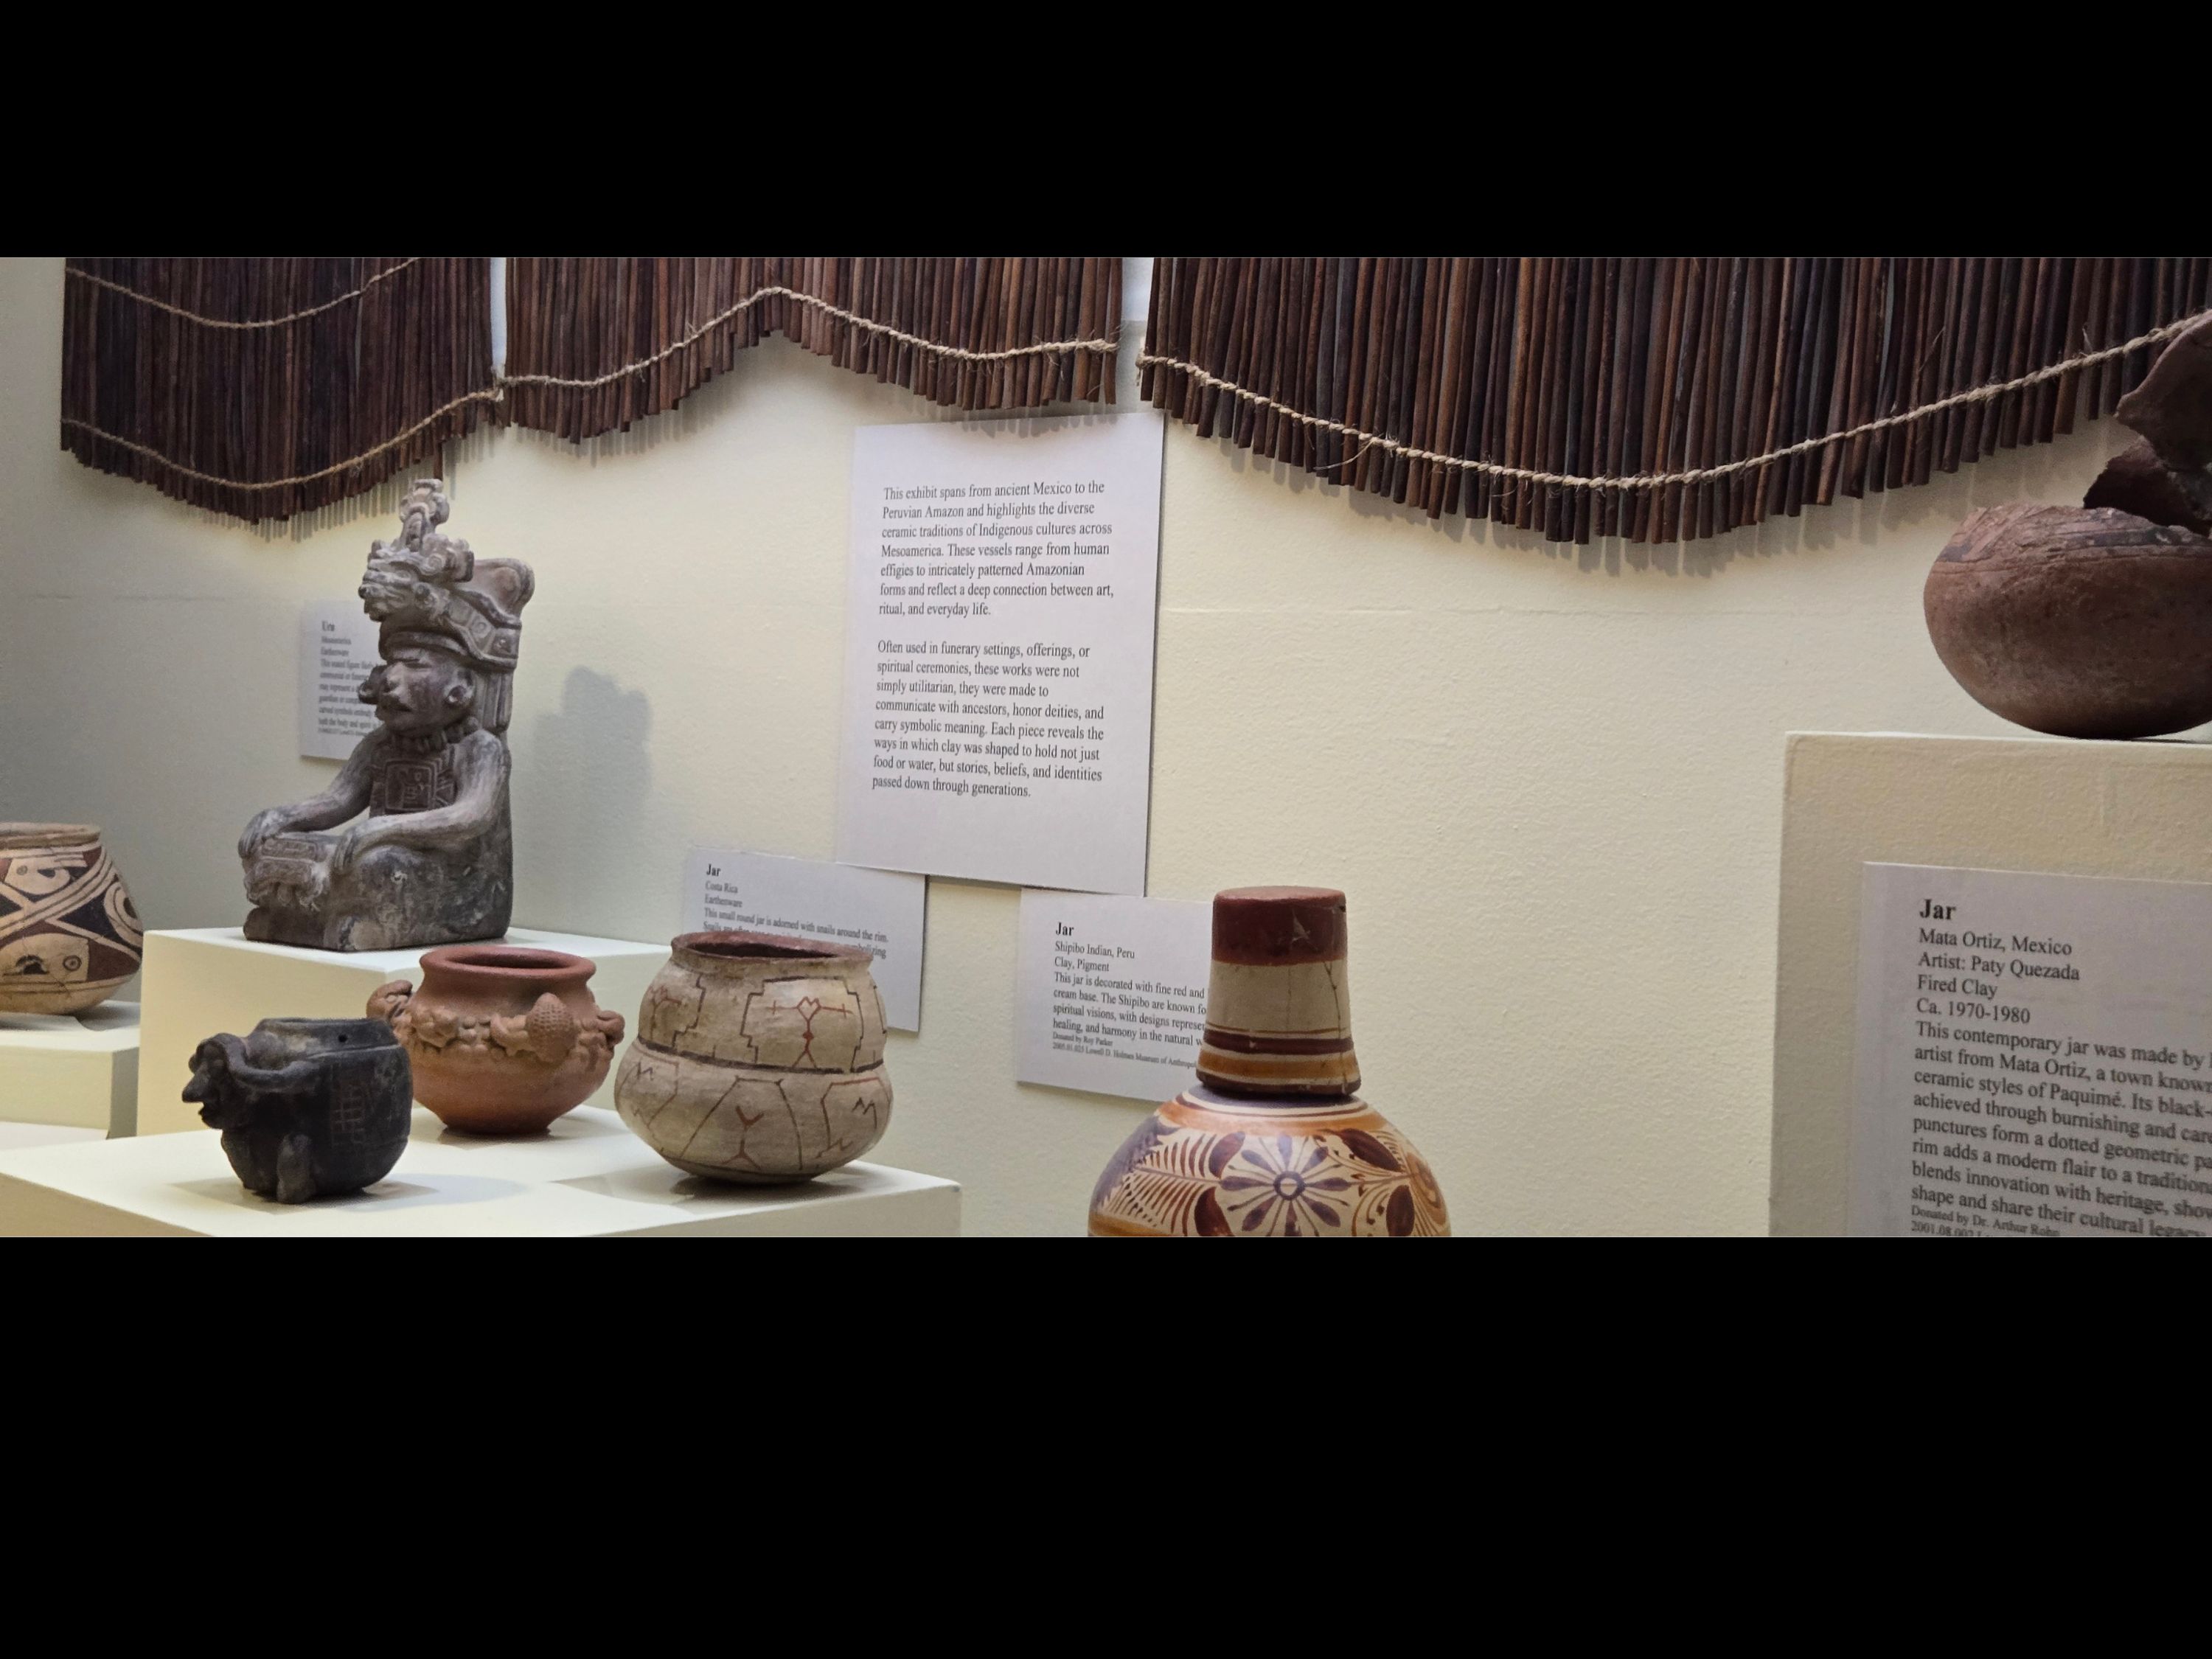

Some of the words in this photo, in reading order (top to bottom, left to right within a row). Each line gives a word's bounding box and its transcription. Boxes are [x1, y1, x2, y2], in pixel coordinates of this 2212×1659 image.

[883, 487, 903, 500] This
[905, 485, 937, 499] exhibit
[939, 487, 966, 501] spans
[968, 484, 992, 497] from
[994, 482, 1030, 496] ancient
[1033, 481, 1072, 495] Mexico
[1074, 482, 1085, 494] to
[1088, 479, 1105, 493] the
[882, 505, 922, 519] Peruvian
[925, 505, 964, 518] Amazon
[967, 503, 984, 517] and
[986, 501, 1035, 519] highlights
[1038, 501, 1054, 515] the
[1057, 501, 1095, 515] diverse
[881, 524, 917, 538] ceramic
[919, 524, 964, 538] traditions
[966, 523, 978, 536] of
[978, 522, 1033, 540] Indigenous
[1035, 521, 1077, 535] cultures
[1079, 524, 1112, 535] across
[881, 543, 944, 557] Mesoamerica.
[947, 543, 975, 557] These
[978, 542, 1012, 556] vessels
[1015, 546, 1043, 559] range
[1046, 541, 1071, 555] from
[1074, 541, 1109, 555] human
[880, 563, 914, 580] effigies
[916, 566, 925, 576] to
[928, 562, 975, 580] intricately
[977, 562, 1023, 580] patterned
[1026, 562, 1085, 576] Amazonian
[706, 863, 721, 877] Jar
[1919, 899, 1956, 920] Jar
[1055, 922, 1074, 936] Jar
[1919, 927, 1958, 946] Mata
[1962, 931, 2006, 953] Ortiz,
[2011, 935, 2072, 956] Mexico
[1054, 940, 1085, 955] Shipibo
[1086, 943, 1114, 958] Indian,
[1116, 946, 1135, 959] Peru
[1054, 956, 1074, 970] Clay,
[1077, 958, 1109, 973] Pigment
[1917, 951, 1966, 971] Artist:
[1970, 955, 2005, 978] Paty
[2009, 959, 2080, 981] Quezada
[1054, 971, 1071, 984] This
[1071, 974, 1084, 987] jar
[1085, 975, 1093, 986] is
[1093, 975, 1133, 990] decorated
[1135, 981, 1152, 992] with
[1155, 982, 1172, 995] fine
[1173, 985, 1186, 997] red
[1189, 987, 1205, 999] and
[1917, 973, 1957, 993] Fired
[1961, 978, 1998, 1001] Clay
[1053, 989, 1077, 1000] cream
[1079, 989, 1098, 1002] base.
[1101, 992, 1116, 1004] The
[1118, 994, 1150, 1009] Shipibo
[1152, 1001, 1165, 1010] are
[1166, 999, 1195, 1014] known
[1198, 1003, 1207, 1015] fo
[1916, 997, 1942, 1015] Ca.
[1949, 1001, 2031, 1024] 1970-1980
[1053, 1004, 1084, 1016] spiritual
[1086, 1007, 1116, 1021] visions,
[1119, 1011, 1137, 1023] with
[1138, 1012, 1169, 1029] designs
[1052, 1018, 1083, 1034] healing,
[1085, 1022, 1099, 1034] and
[1102, 1023, 1137, 1041] harmony
[1139, 1028, 1147, 1040] in
[1149, 1029, 1162, 1042] the
[1164, 1034, 1193, 1046] natural
[1915, 1020, 1950, 1039] This
[1952, 1029, 2062, 1056] contemporary
[2064, 1036, 2090, 1057] jar
[2093, 1043, 2126, 1060] was
[2130, 1046, 2178, 1065] made
[2182, 1049, 2205, 1071] by
[1914, 1046, 1952, 1063] artist
[1958, 1048, 1994, 1068] from
[1999, 1052, 2040, 1074] Mata
[2044, 1058, 2091, 1082] Ortiz,
[2096, 1068, 2106, 1082] a
[2110, 1068, 2153, 1087] town
[1913, 1071, 1975, 1090] ceramic
[1978, 1077, 2024, 1096] styles
[2027, 1081, 2048, 1099] of
[2047, 1082, 2126, 1108] Paquimé.
[2132, 1092, 2153, 1112] Its
[1913, 1092, 1981, 1114] achieved
[1984, 1099, 2048, 1126] through
[2051, 1107, 2141, 1139] burnishing
[2143, 1122, 2177, 1140] and
[1913, 1118, 1988, 1138] punctures
[1992, 1124, 2030, 1144] form
[2034, 1134, 2044, 1147] a
[2048, 1132, 2100, 1155] dotted
[2103, 1143, 2189, 1167] geometric
[1912, 1141, 1938, 1156] rim
[1943, 1143, 1978, 1161] adds
[1982, 1150, 1992, 1164] a
[1995, 1152, 2058, 1172] modern
[2062, 1158, 2097, 1178] flair
[2100, 1165, 2118, 1181] to
[2121, 1170, 2133, 1184] a
[1911, 1159, 1961, 1184] blends
[1966, 1167, 2050, 1196] innovation
[2053, 1182, 2091, 1202] with
[2095, 1186, 2169, 1216] heritage,
[1911, 1184, 1955, 1208] shape
[1958, 1193, 1987, 1210] and
[1991, 1196, 2034, 1217] share
[2037, 1203, 2076, 1224] their
[2079, 1211, 2143, 1234] cultural
